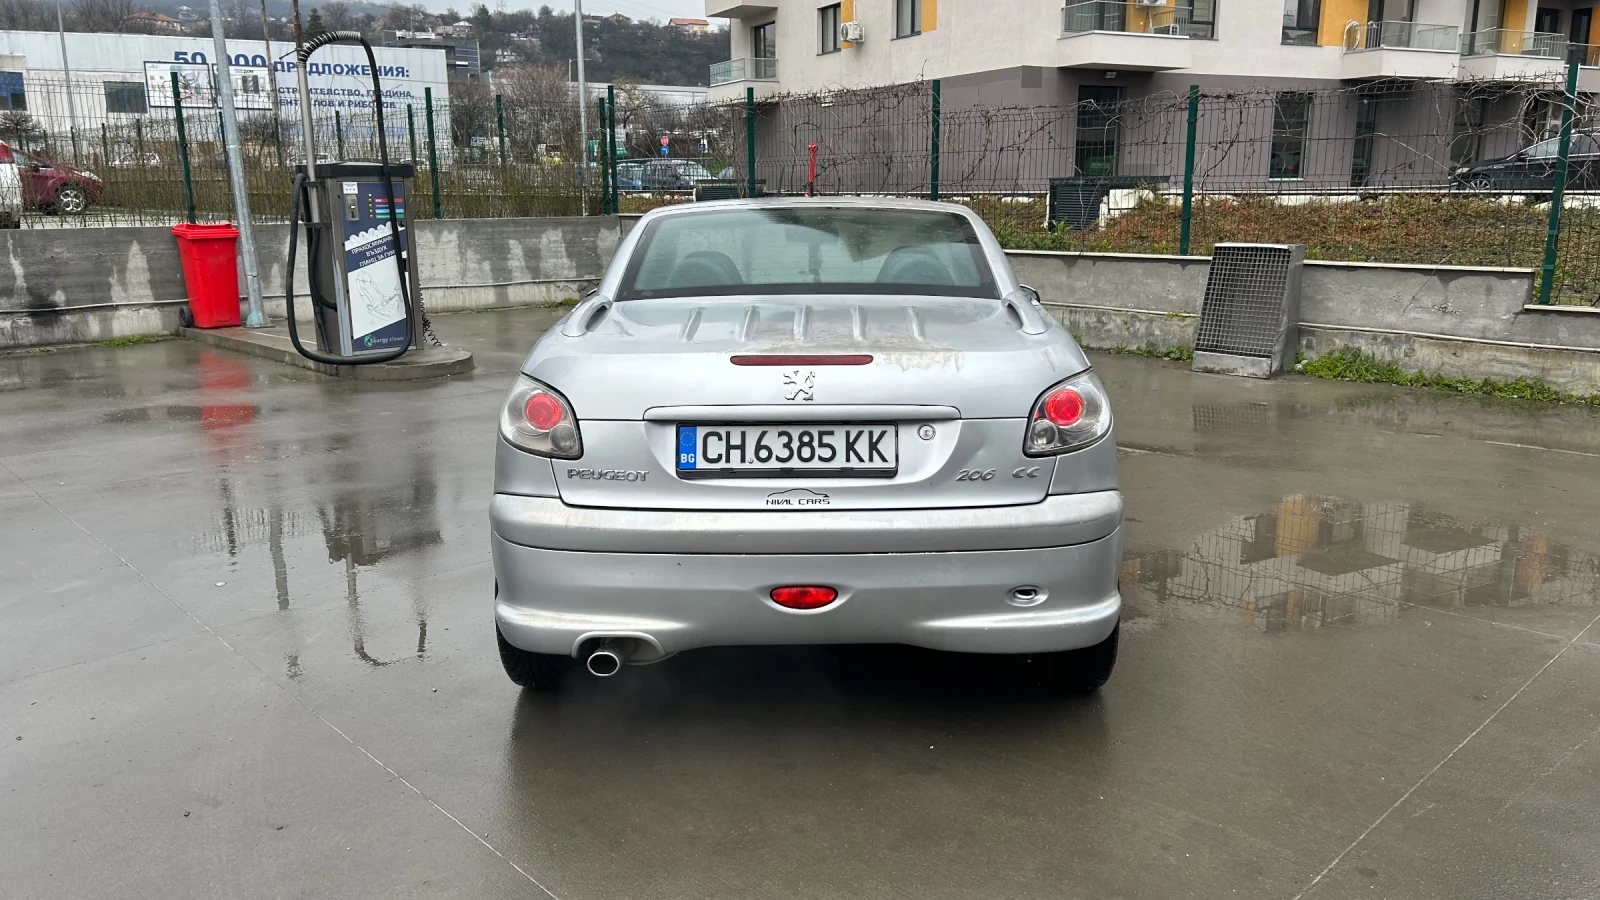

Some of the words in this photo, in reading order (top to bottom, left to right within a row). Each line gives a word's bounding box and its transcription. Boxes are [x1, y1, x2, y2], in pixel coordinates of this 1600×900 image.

[273, 61, 410, 78] ПРДЛОЖЕНИЯ:
[278, 87, 364, 97] СТРИТЕЛСТВО,
[348, 100, 396, 109] РИБООВ
[702, 430, 746, 463] CH
[754, 430, 837, 463] 6385
[845, 430, 889, 463] KK
[680, 453, 695, 463] BG
[567, 468, 649, 482] PEUGEOT
[956, 468, 996, 481] 206
[1012, 466, 1040, 479] CC
[766, 498, 794, 506] NIVAL
[798, 498, 831, 506] CARS
